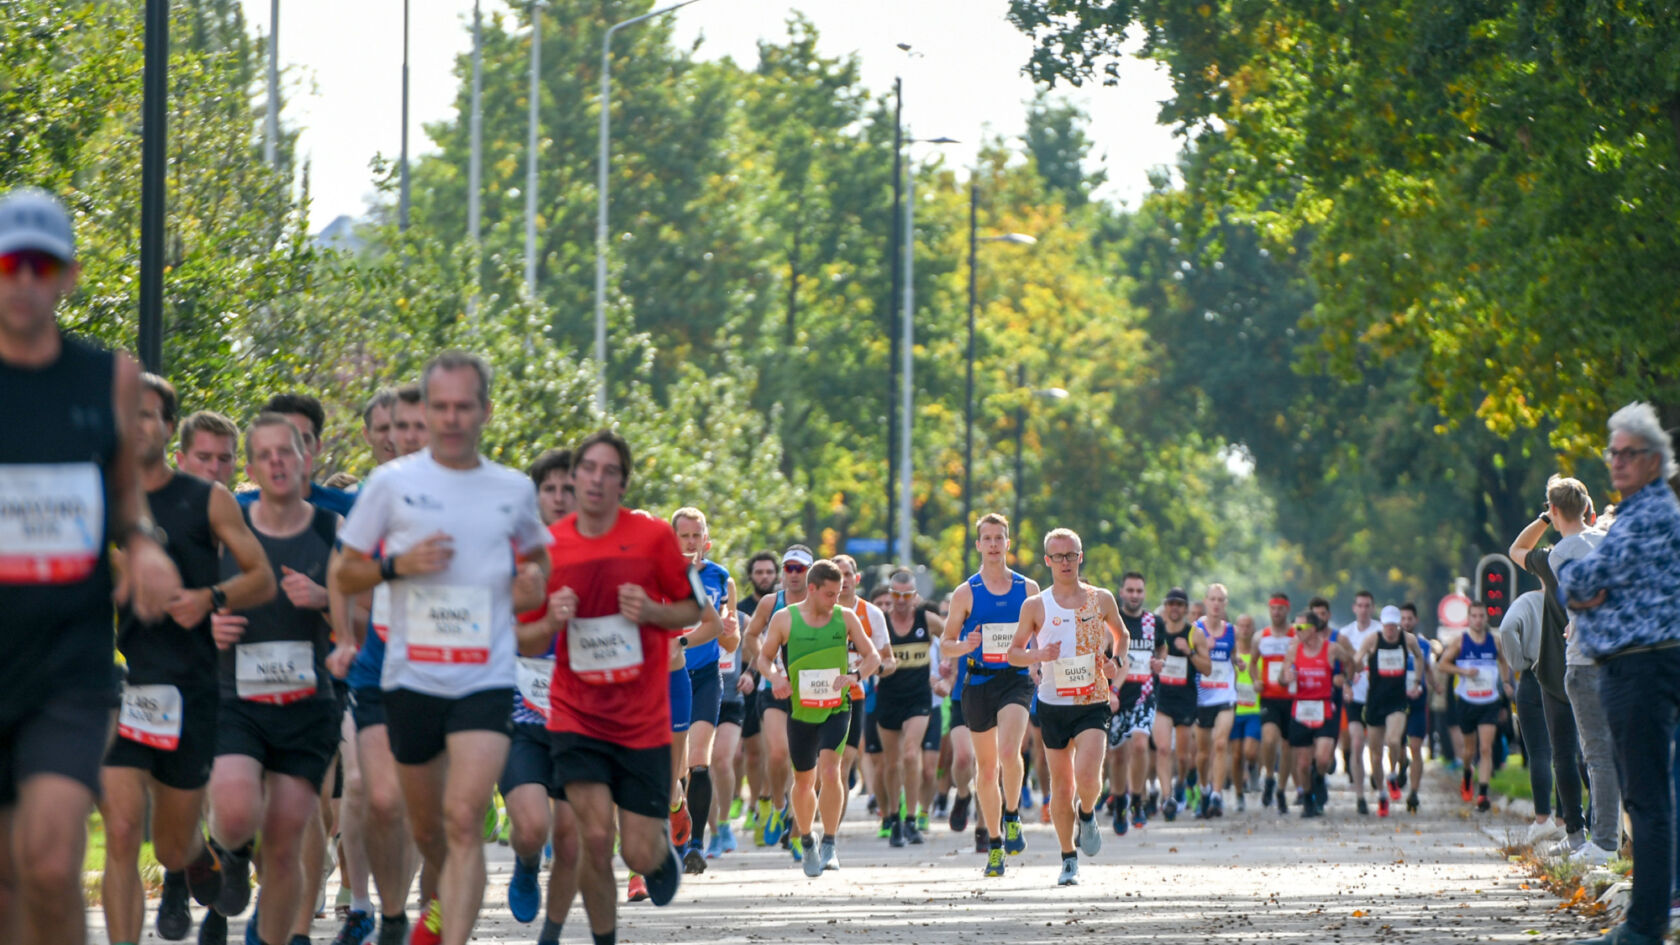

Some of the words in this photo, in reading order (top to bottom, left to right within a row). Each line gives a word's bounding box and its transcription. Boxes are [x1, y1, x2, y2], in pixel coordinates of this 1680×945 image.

[580, 633, 626, 649] DANIEL
[256, 661, 295, 674] NIELS
[1064, 666, 1087, 676] GUUS
